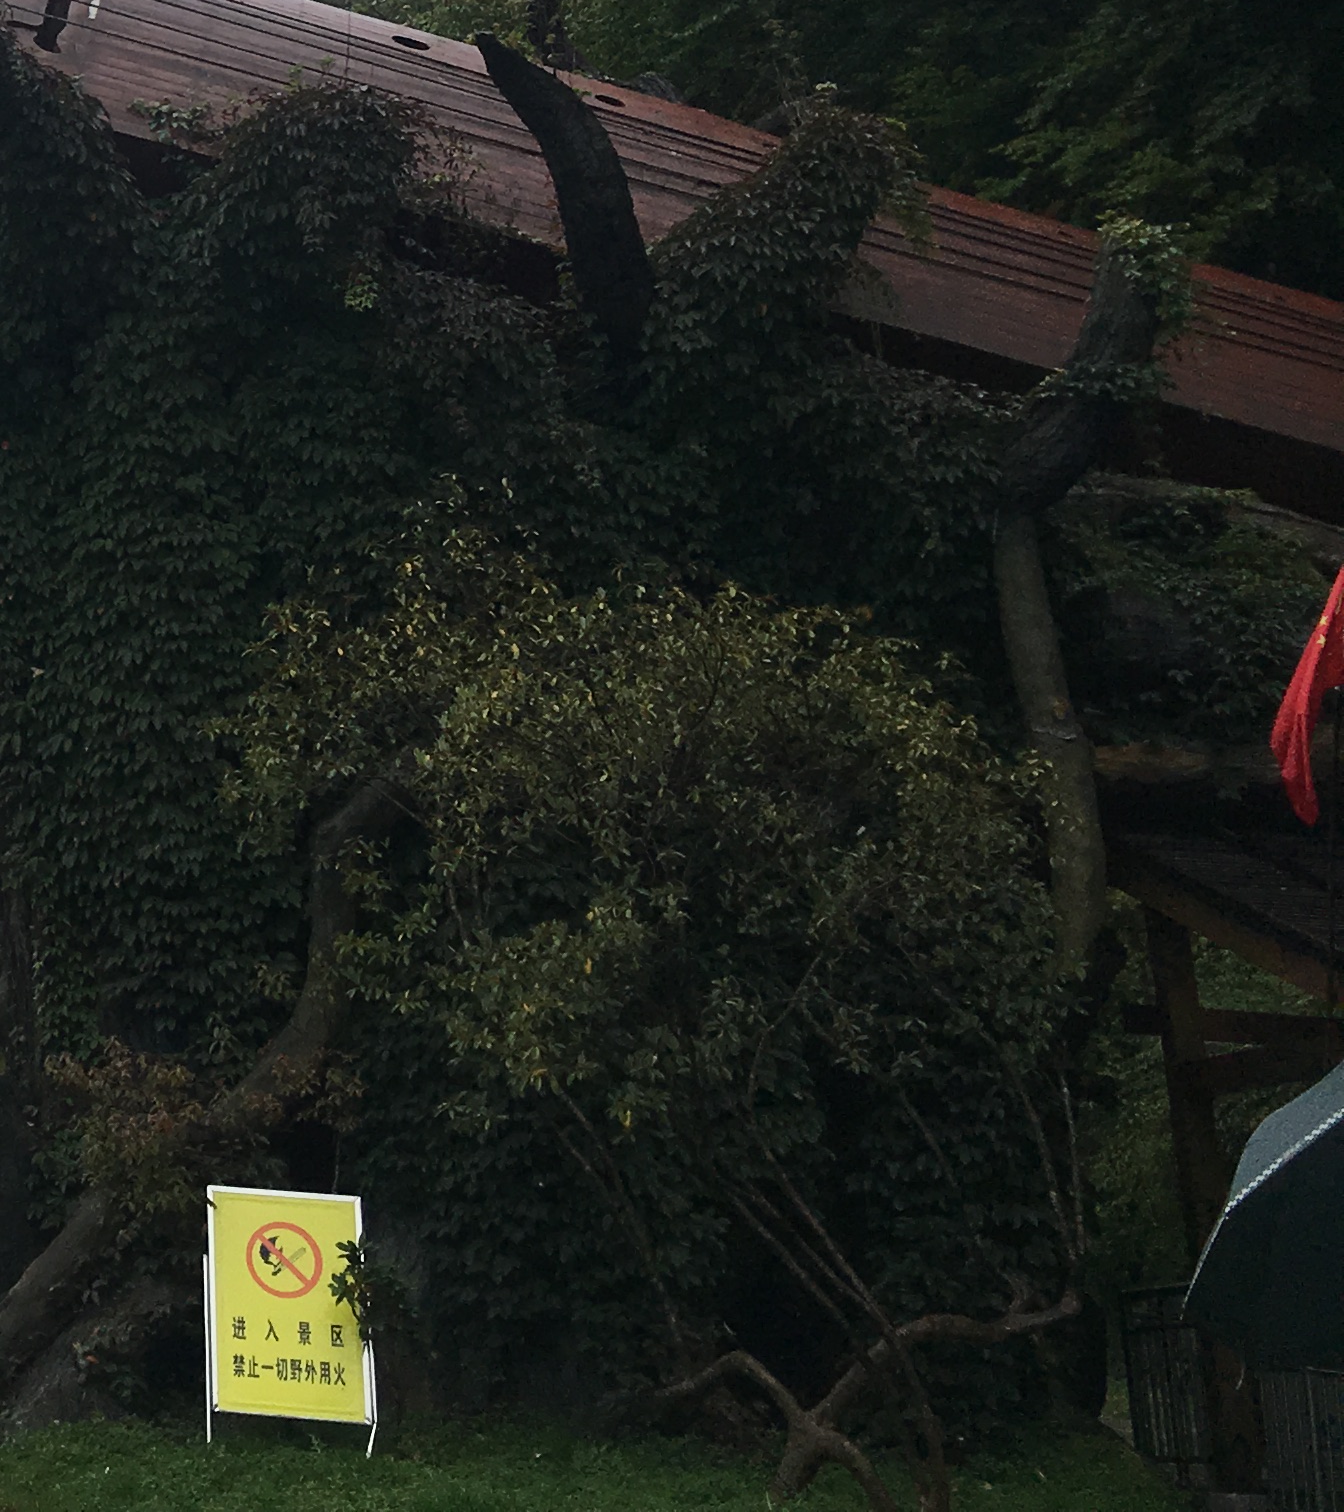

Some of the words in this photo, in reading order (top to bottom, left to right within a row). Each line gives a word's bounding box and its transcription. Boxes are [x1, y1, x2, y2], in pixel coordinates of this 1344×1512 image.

[232, 1316, 345, 1347] 进入景区
[232, 1354, 346, 1387] 禁止一切野外用火
